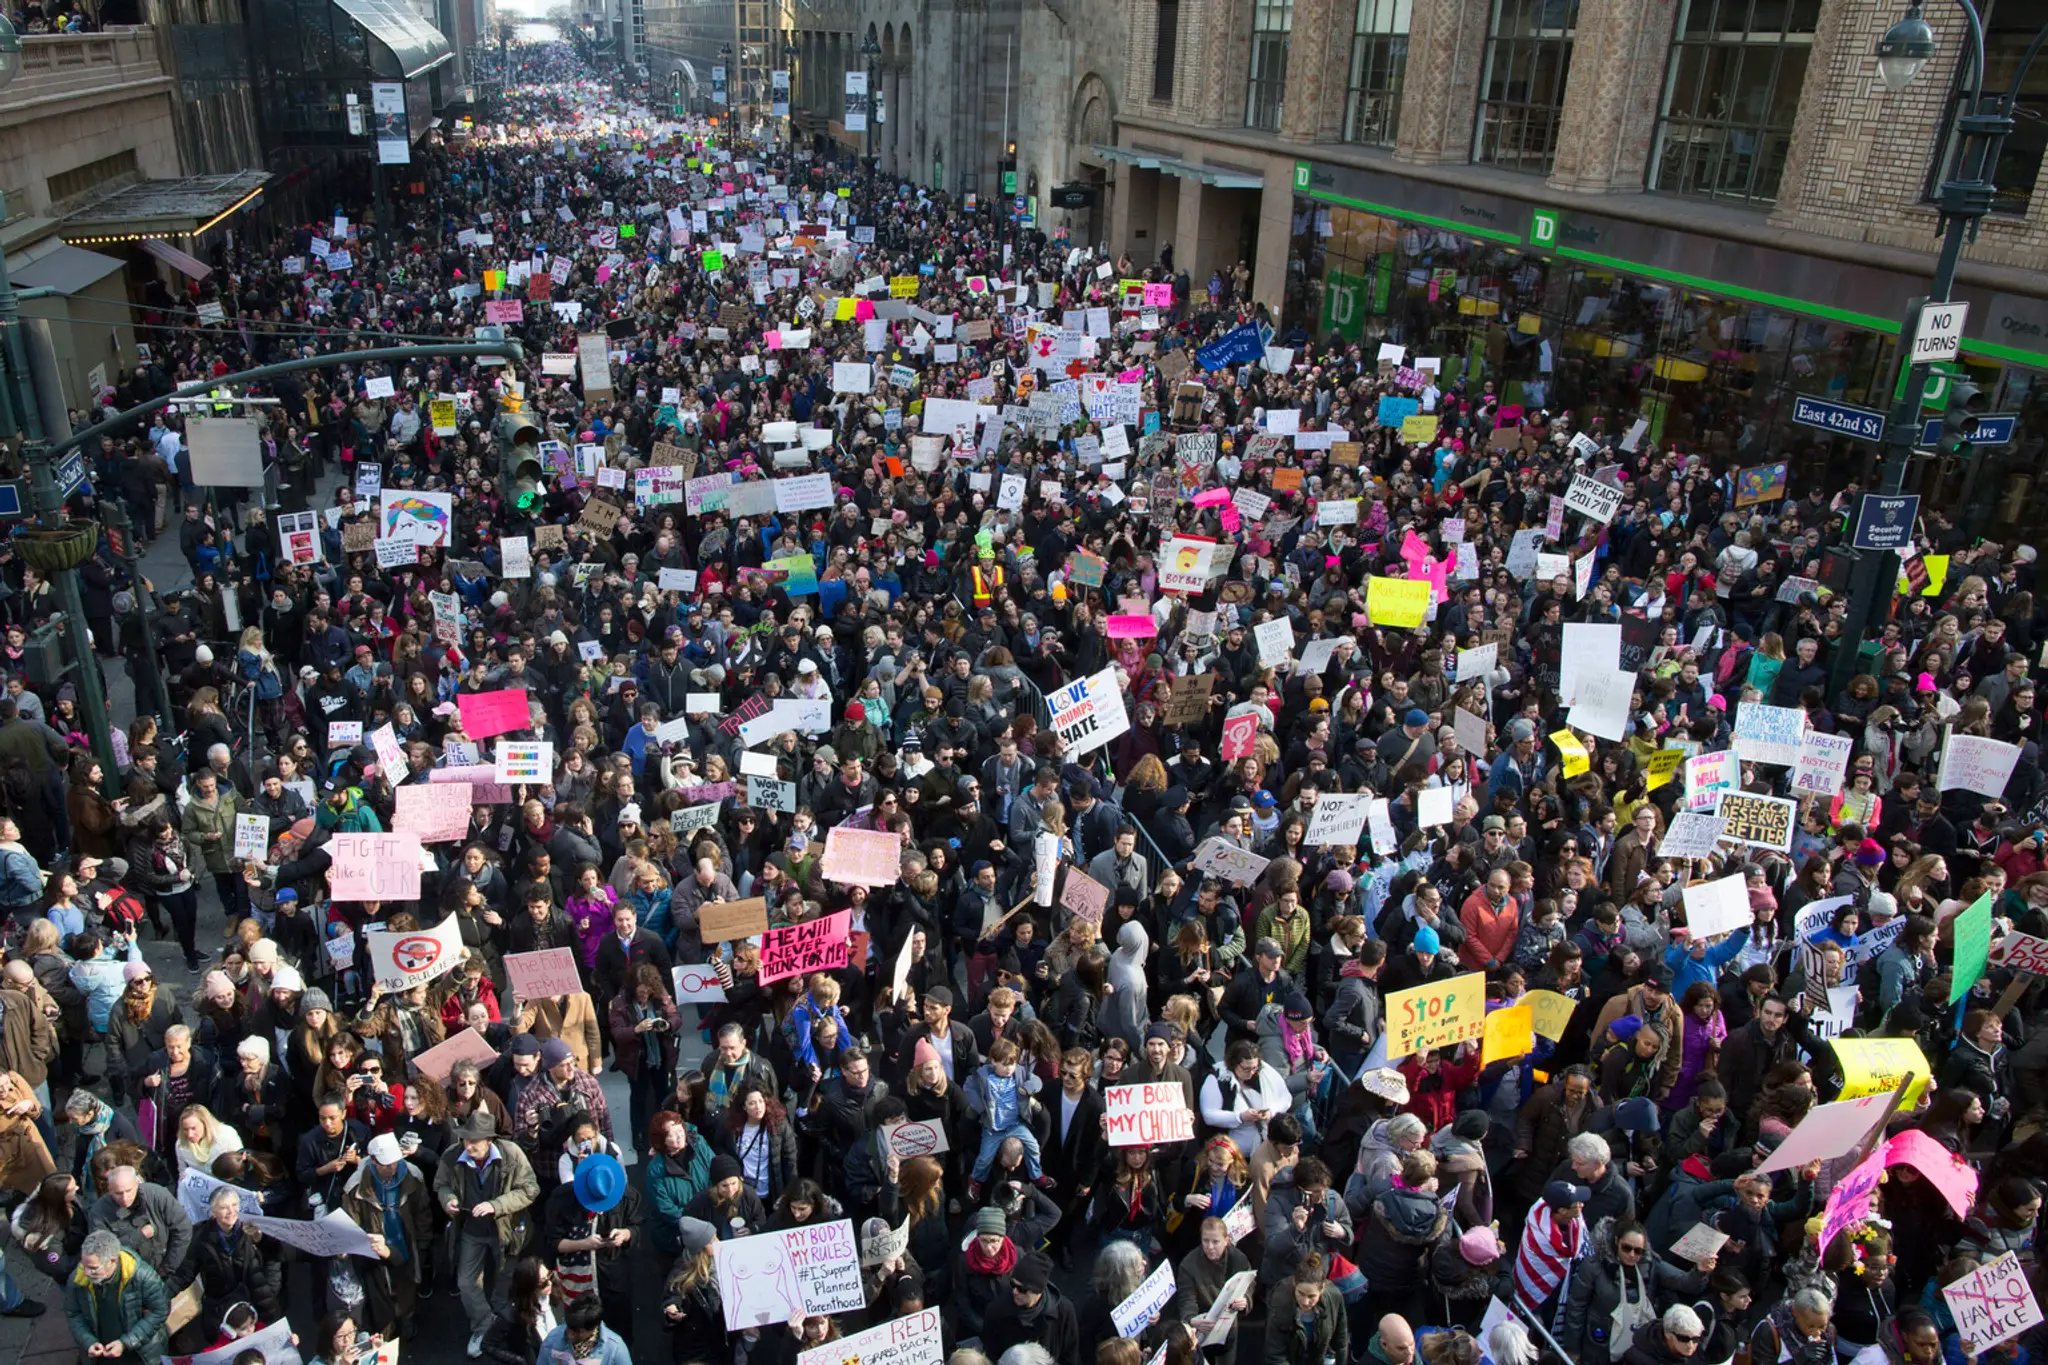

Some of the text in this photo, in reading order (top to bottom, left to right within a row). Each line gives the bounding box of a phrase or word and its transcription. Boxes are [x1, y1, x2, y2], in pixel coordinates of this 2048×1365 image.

[1931, 313, 1952, 330] NO
[1917, 335, 1958, 352] TURNS
[1797, 403, 1879, 436] East 42nd St
[1975, 424, 1997, 440] Ave
[635, 467, 673, 480] FEMALES
[636, 494, 647, 506] AS
[649, 492, 673, 504] HELL
[1570, 475, 1622, 505] IMPEACH
[579, 517, 611, 537] ANNOYED
[1869, 525, 1904, 535] Security
[1868, 533, 1902, 542] Camera
[1165, 573, 1183, 584] BOY
[1048, 680, 1090, 715] LOVE
[718, 692, 770, 737] TRUTH
[1054, 699, 1095, 728] TRUMPS
[1060, 714, 1099, 746] HATE
[1805, 735, 1852, 752] LIBERTY
[1799, 755, 1842, 772] JUSTICE
[754, 778, 787, 792] WONT
[1798, 773, 1833, 793] ALL
[756, 797, 785, 810] BACK
[761, 789, 779, 799] GO
[1320, 801, 1345, 812] NOT
[1724, 795, 1789, 815] AMERICA
[673, 817, 715, 832] PEOPLE
[674, 809, 715, 822] WE THE
[1320, 813, 1336, 823] MY
[1721, 804, 1789, 828] DESERVES
[1724, 823, 1787, 846] BETTER
[338, 838, 401, 858] FIGHT
[336, 864, 367, 880] like a
[369, 860, 421, 895] GIRL
[765, 927, 794, 949] HE
[2012, 935, 2048, 955] PU
[768, 938, 823, 960] NEVER
[505, 956, 538, 977] The
[763, 957, 800, 979] THINK
[826, 941, 849, 967] ME!
[385, 979, 404, 990] NO
[527, 976, 579, 998] FEMALE
[1880, 1075, 1905, 1088] NEVE
[1107, 1084, 1183, 1107] MY BODY
[1109, 1109, 1193, 1144] MY CHOICE
[188, 1175, 210, 1191] MEN
[786, 1220, 848, 1248] MY BODY
[790, 1248, 810, 1267] MY
[811, 1239, 852, 1261] RULES
[814, 1279, 860, 1296] Planned
[1111, 1264, 1172, 1322] CONSTRUYE
[805, 1295, 864, 1315] Parenthood
[1123, 1282, 1176, 1338] JUSTICIA
[1960, 1290, 2008, 1328] HAVE
[859, 1329, 884, 1346] are
[890, 1310, 939, 1345] RED,
[1969, 1304, 2032, 1344] A VOICE
[861, 1334, 940, 1365] GRABS BACK,
[913, 1347, 933, 1364] ME
